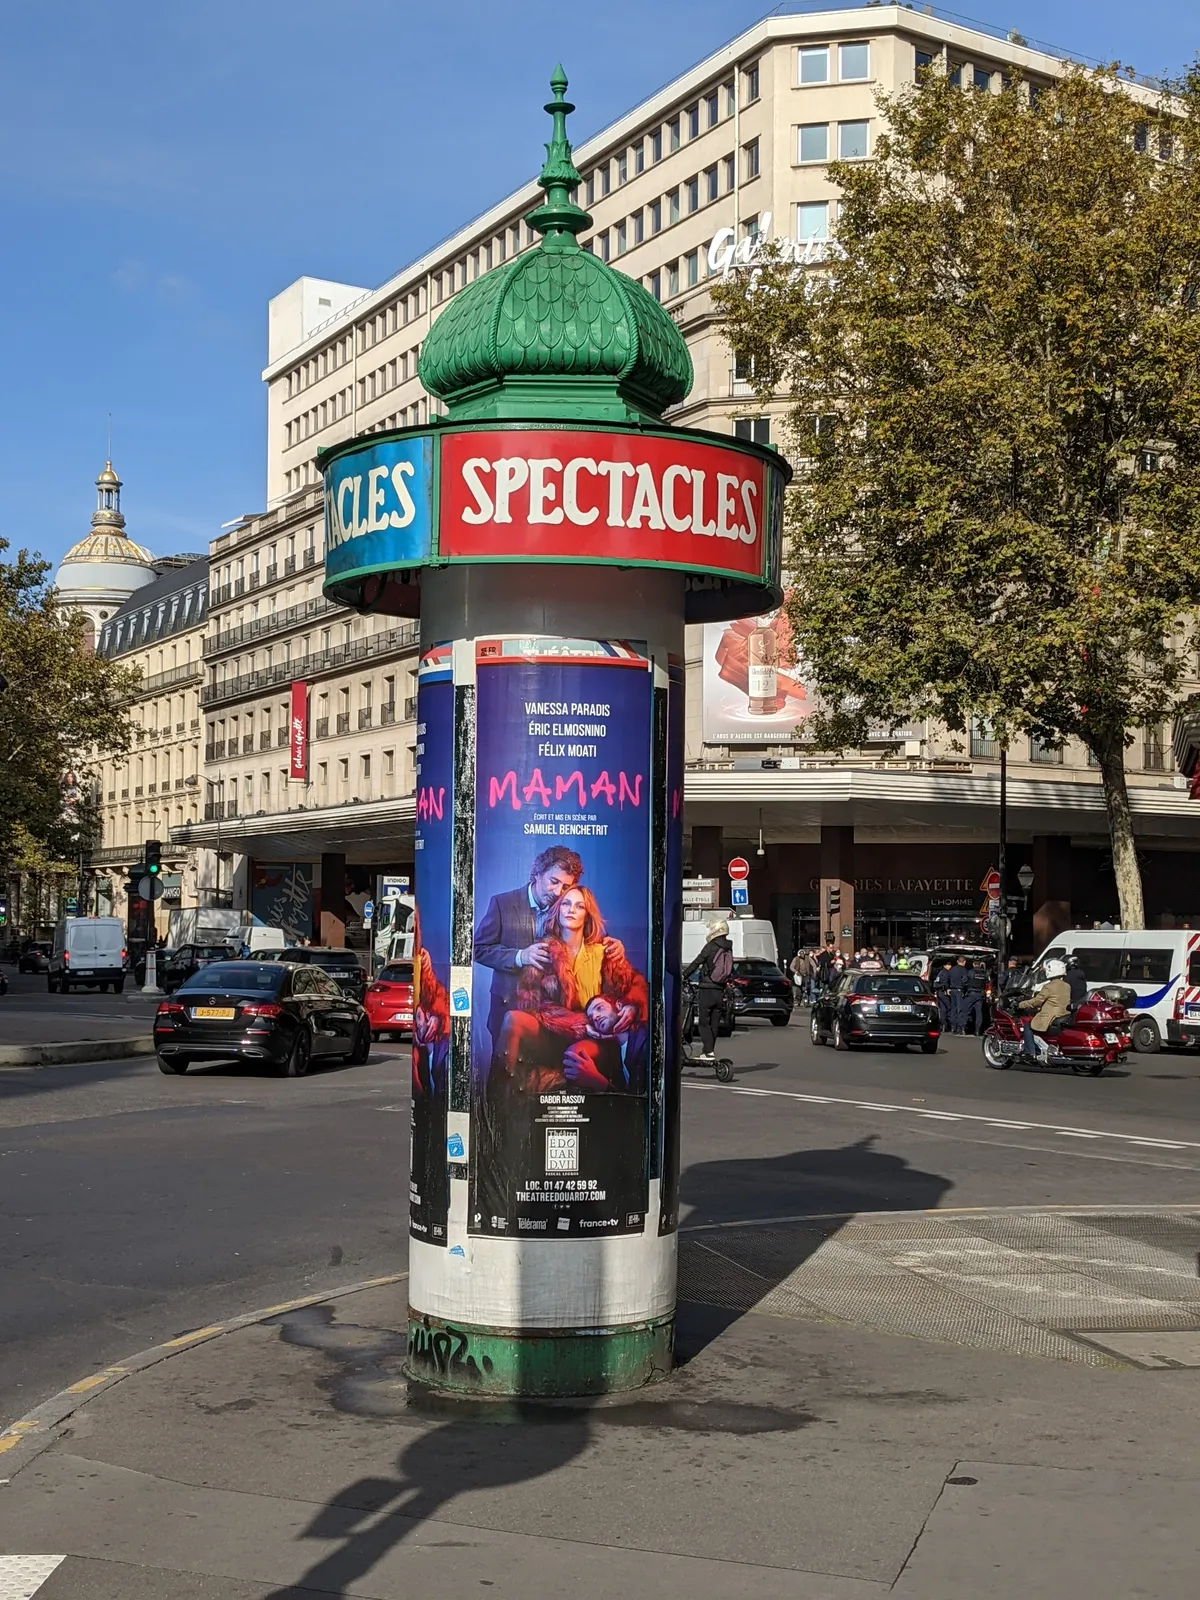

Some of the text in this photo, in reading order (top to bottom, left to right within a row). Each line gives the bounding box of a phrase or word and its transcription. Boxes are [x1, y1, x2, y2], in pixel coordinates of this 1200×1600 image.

[461, 456, 758, 545] SPECTACLES
[525, 702, 610, 717] VANESSA PARADIS
[528, 720, 606, 737] ÉRIC ELMOSNINO
[538, 741, 597, 757] FÉLIX MOATI
[488, 768, 643, 811] MAMAN
[533, 813, 547, 821] ÉCRIT
[572, 814, 587, 822] SCÈNE
[587, 814, 597, 822] PAR
[523, 823, 608, 836] SAMUEL BENCHETRIT
[888, 879, 973, 891] LAFAYETTE
[931, 898, 973, 906] L'HOMME
[540, 1095, 585, 1104] GABOR RASSOV
[549, 1149, 575, 1159] UAR
[525, 1180, 598, 1190] LOC. 01 47 42 59 92
[515, 1190, 606, 1202] THEATREEDOUARD7.COM
